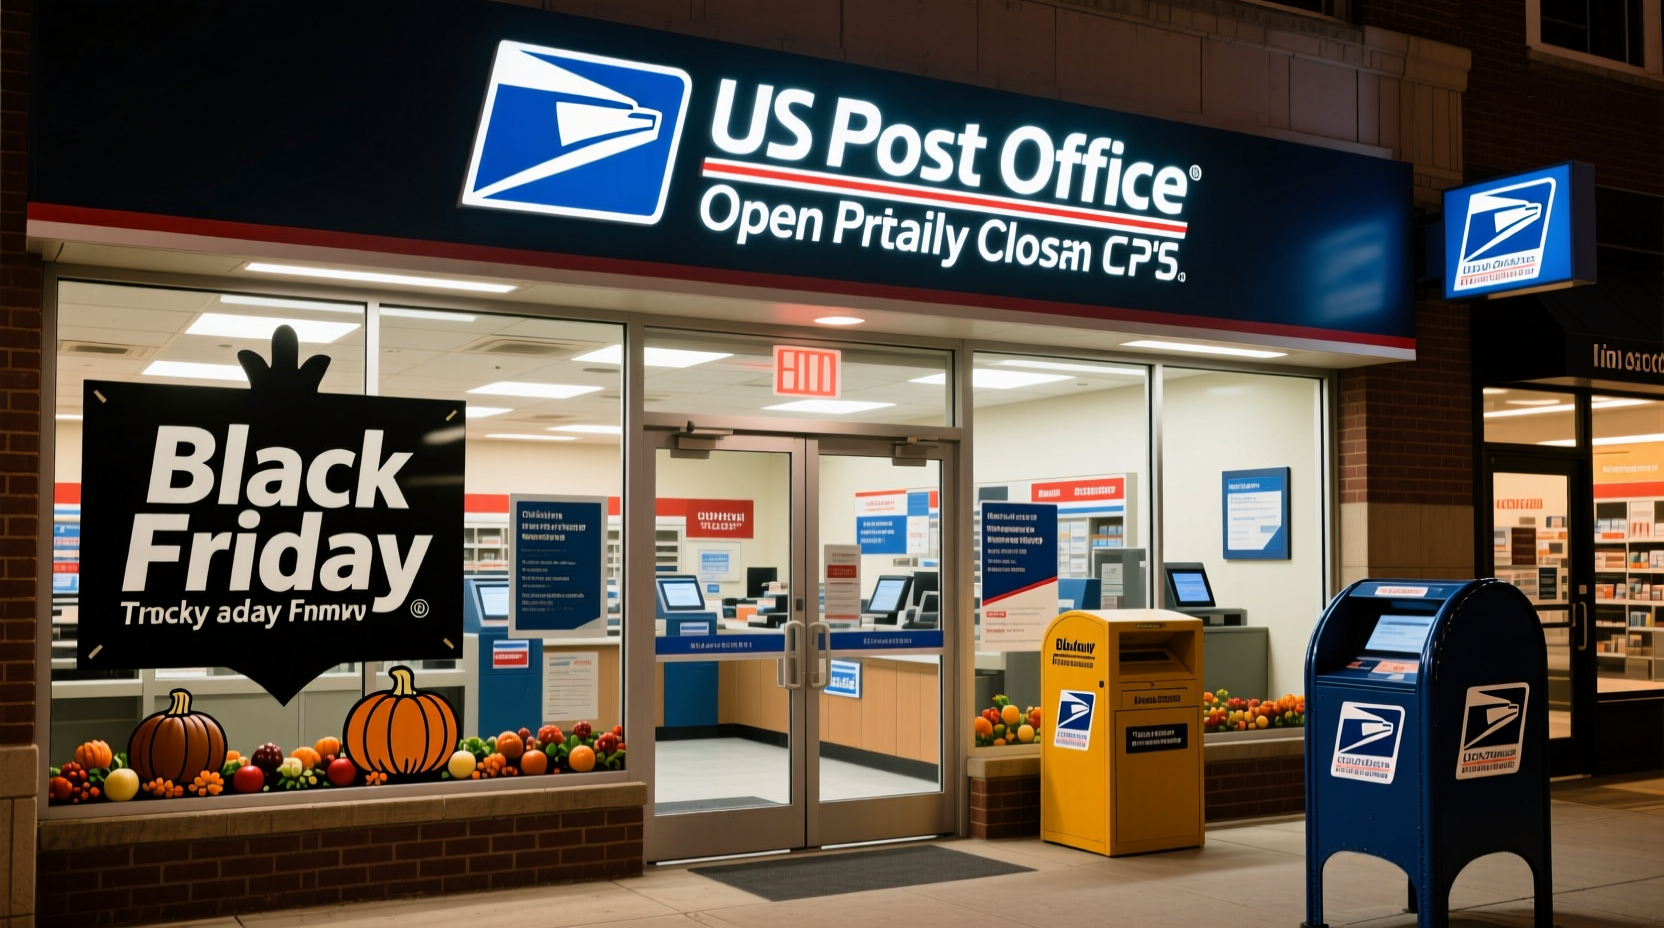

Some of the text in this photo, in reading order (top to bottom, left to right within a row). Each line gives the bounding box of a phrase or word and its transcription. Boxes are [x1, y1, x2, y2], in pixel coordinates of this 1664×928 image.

[711, 78, 815, 161] US
[826, 97, 988, 187] Post
[699, 184, 824, 245] Open
[146, 424, 414, 509] Black
[121, 509, 433, 613] Friday
[216, 598, 283, 630] aday
